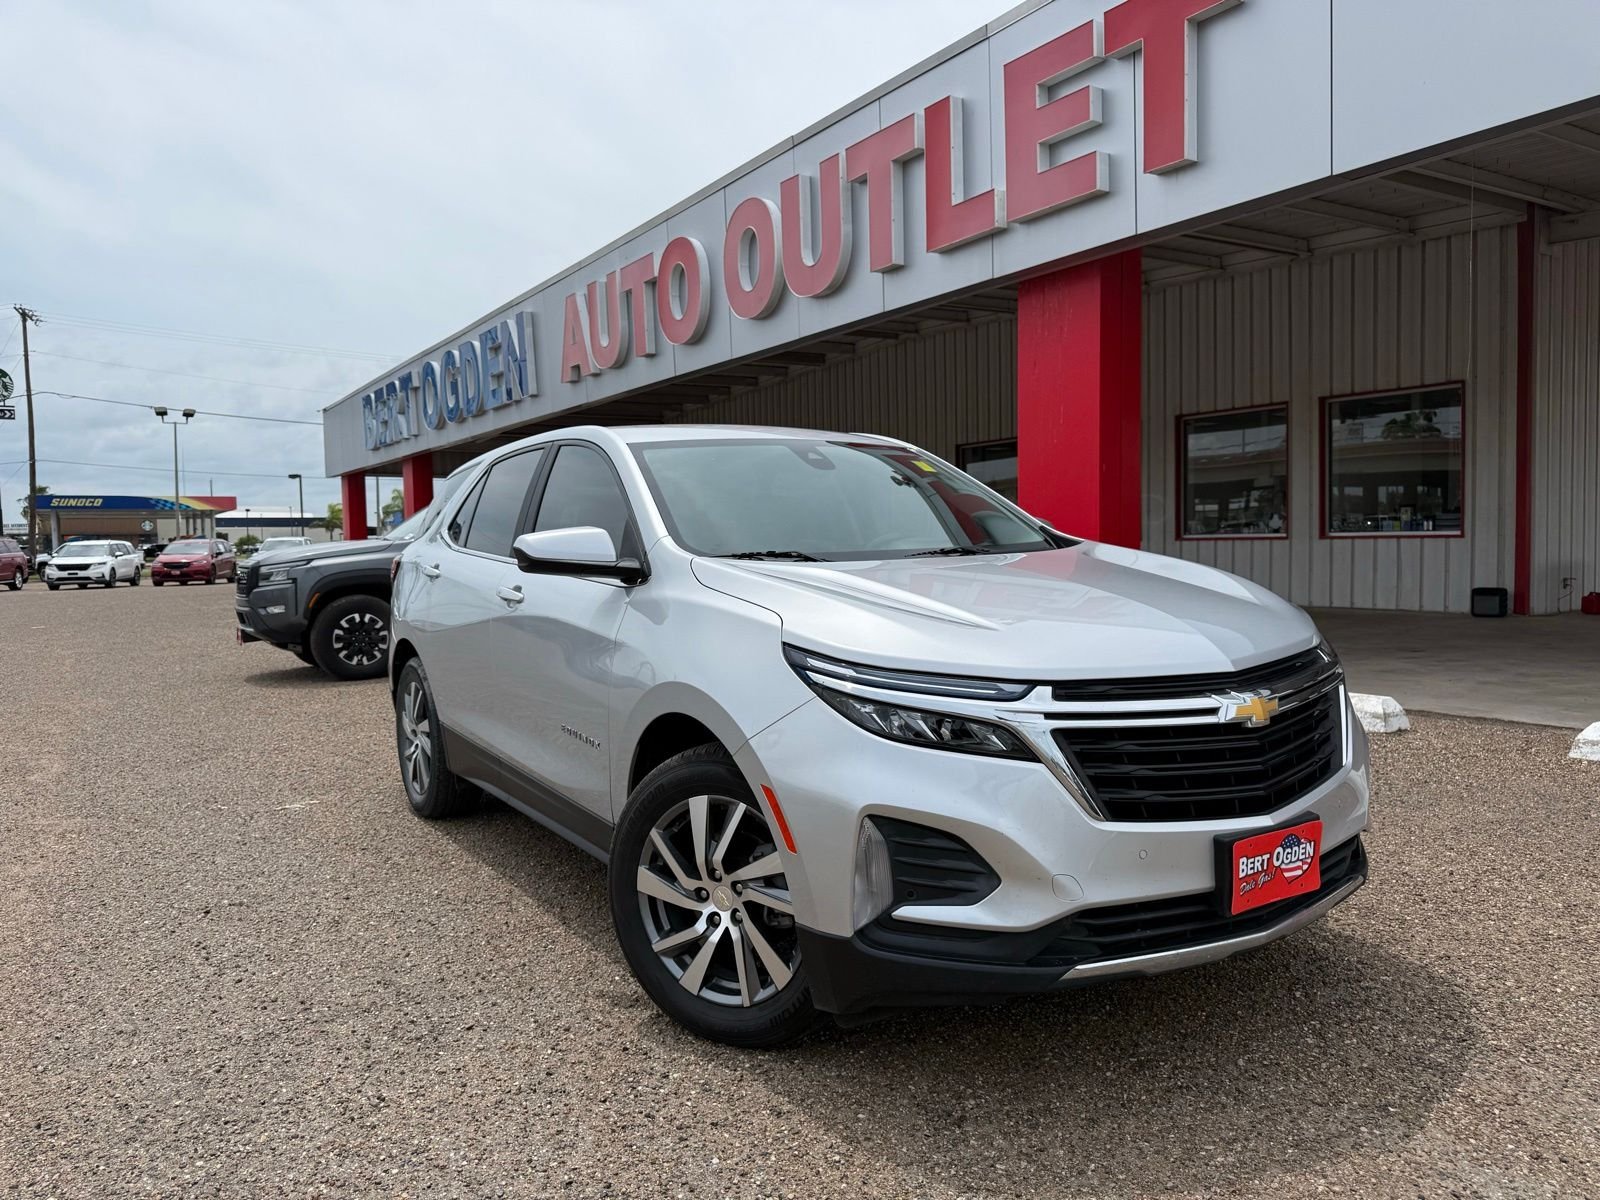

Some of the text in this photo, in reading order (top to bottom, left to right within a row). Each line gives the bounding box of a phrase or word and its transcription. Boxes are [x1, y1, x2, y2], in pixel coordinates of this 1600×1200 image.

[362, 0, 1242, 451] BERT OGDEN AUTO OUTLET
[50, 498, 103, 507] SUNOCO
[1239, 841, 1315, 879] BERT OGDEN
